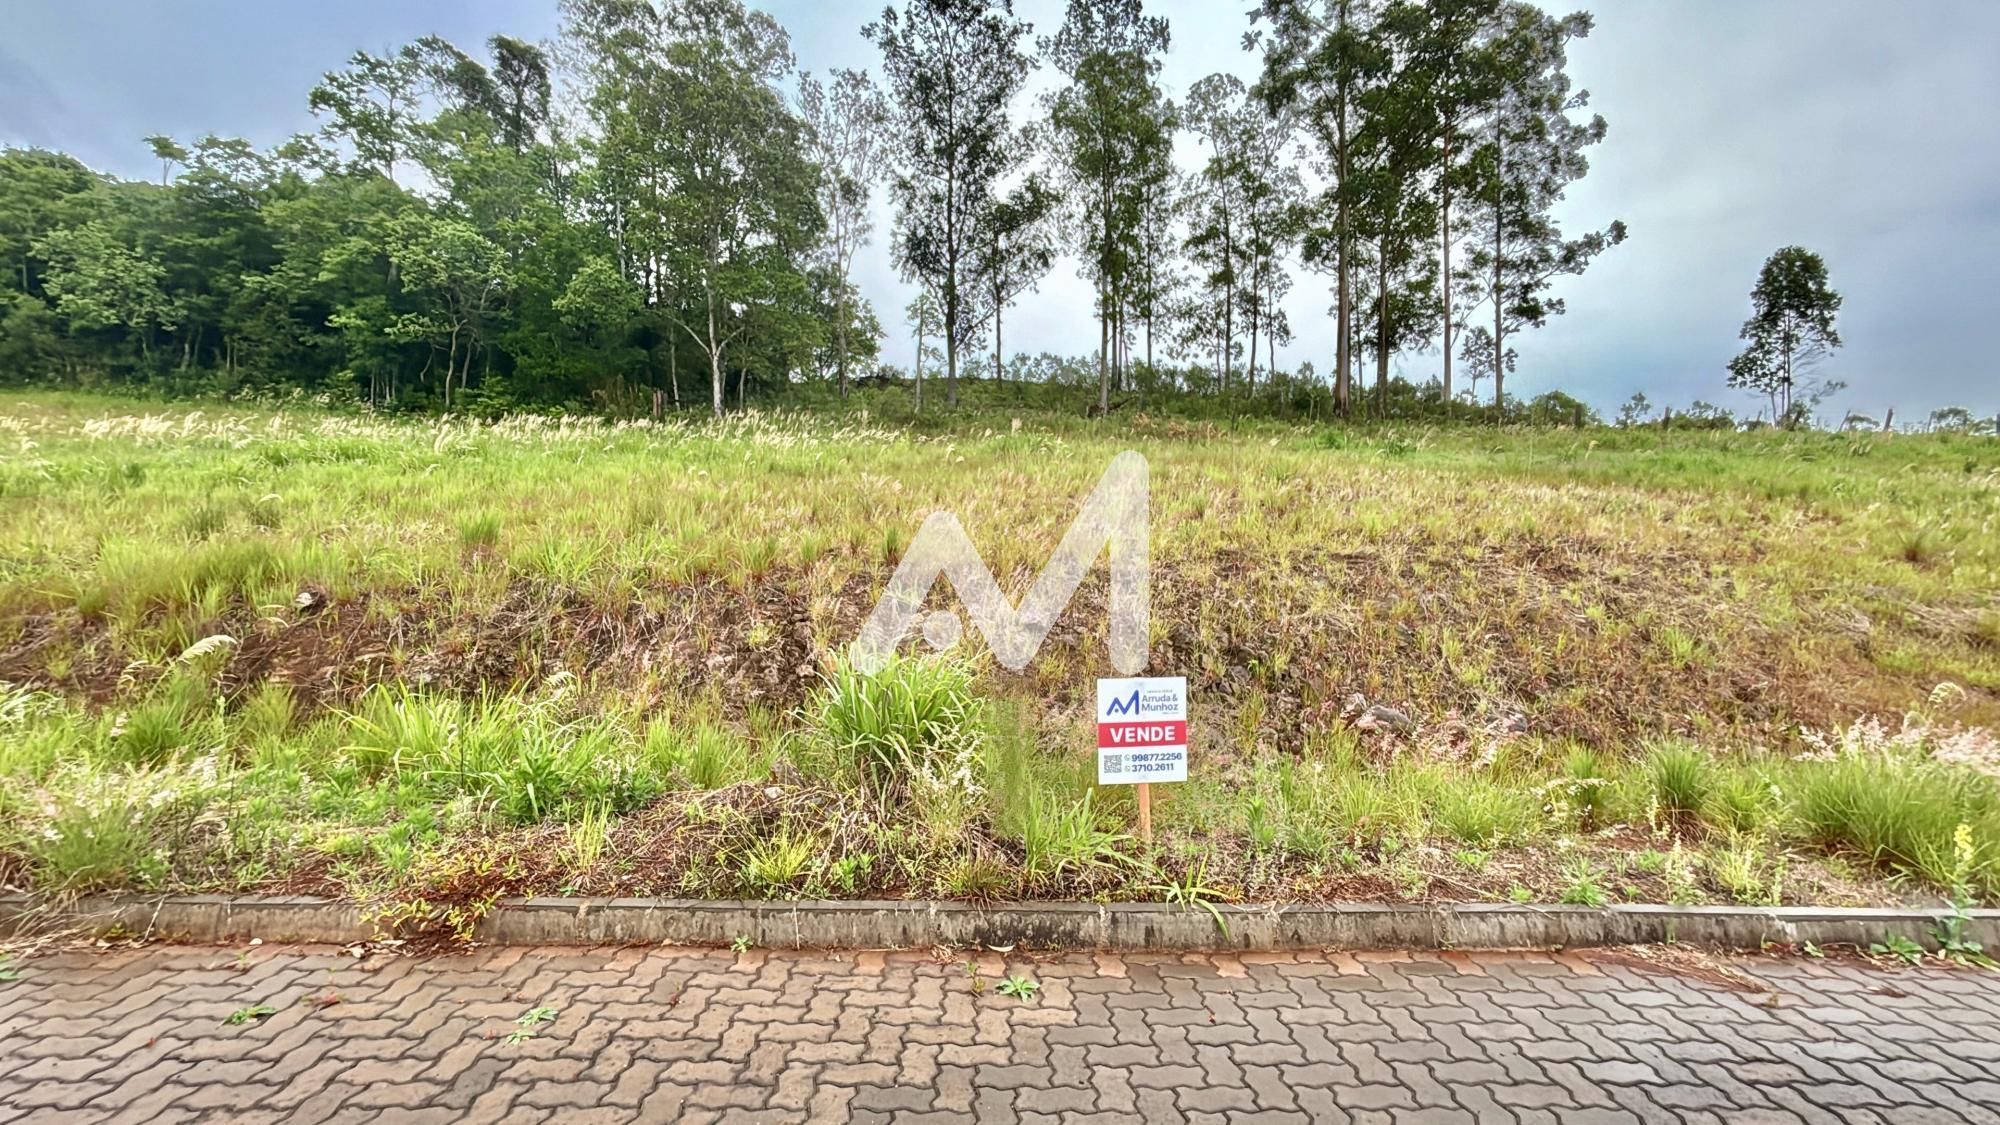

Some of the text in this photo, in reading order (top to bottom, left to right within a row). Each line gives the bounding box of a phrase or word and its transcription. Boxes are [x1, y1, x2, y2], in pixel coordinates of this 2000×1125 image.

[1142, 693, 1178, 702] Arruda &
[1141, 703, 1178, 711] Munhoz
[1109, 726, 1175, 743] VENDE
[1131, 763, 1174, 772] 3710.2611
